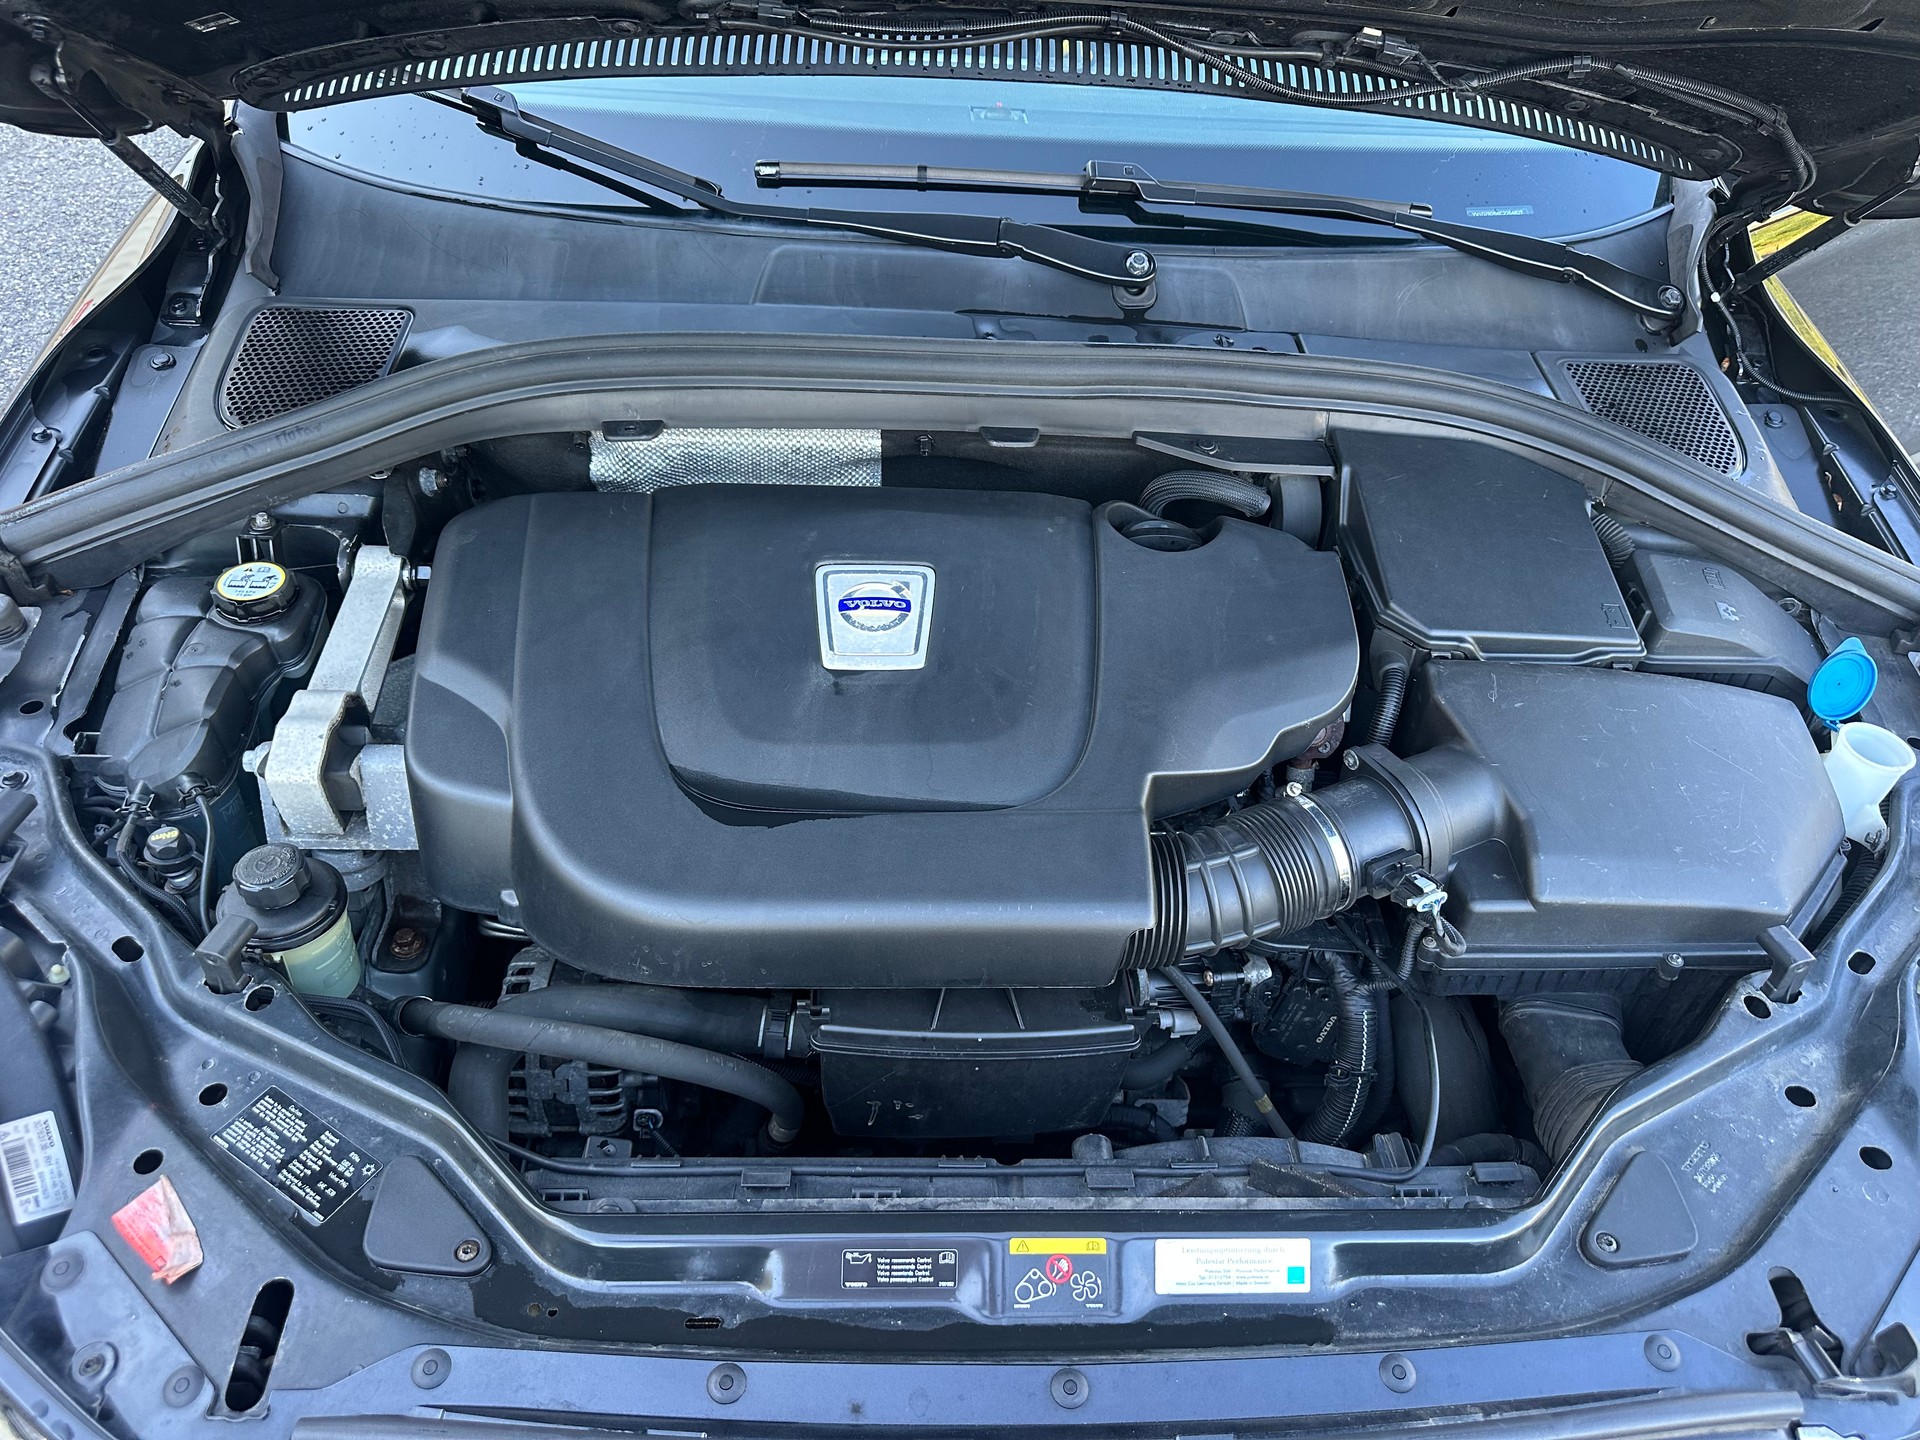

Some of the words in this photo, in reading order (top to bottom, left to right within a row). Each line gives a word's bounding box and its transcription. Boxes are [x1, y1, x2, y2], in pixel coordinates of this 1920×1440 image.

[843, 600, 907, 608] VOLVO
[1316, 1015, 1337, 1043] VOLVO
[43, 1119, 55, 1148] VOLVO
